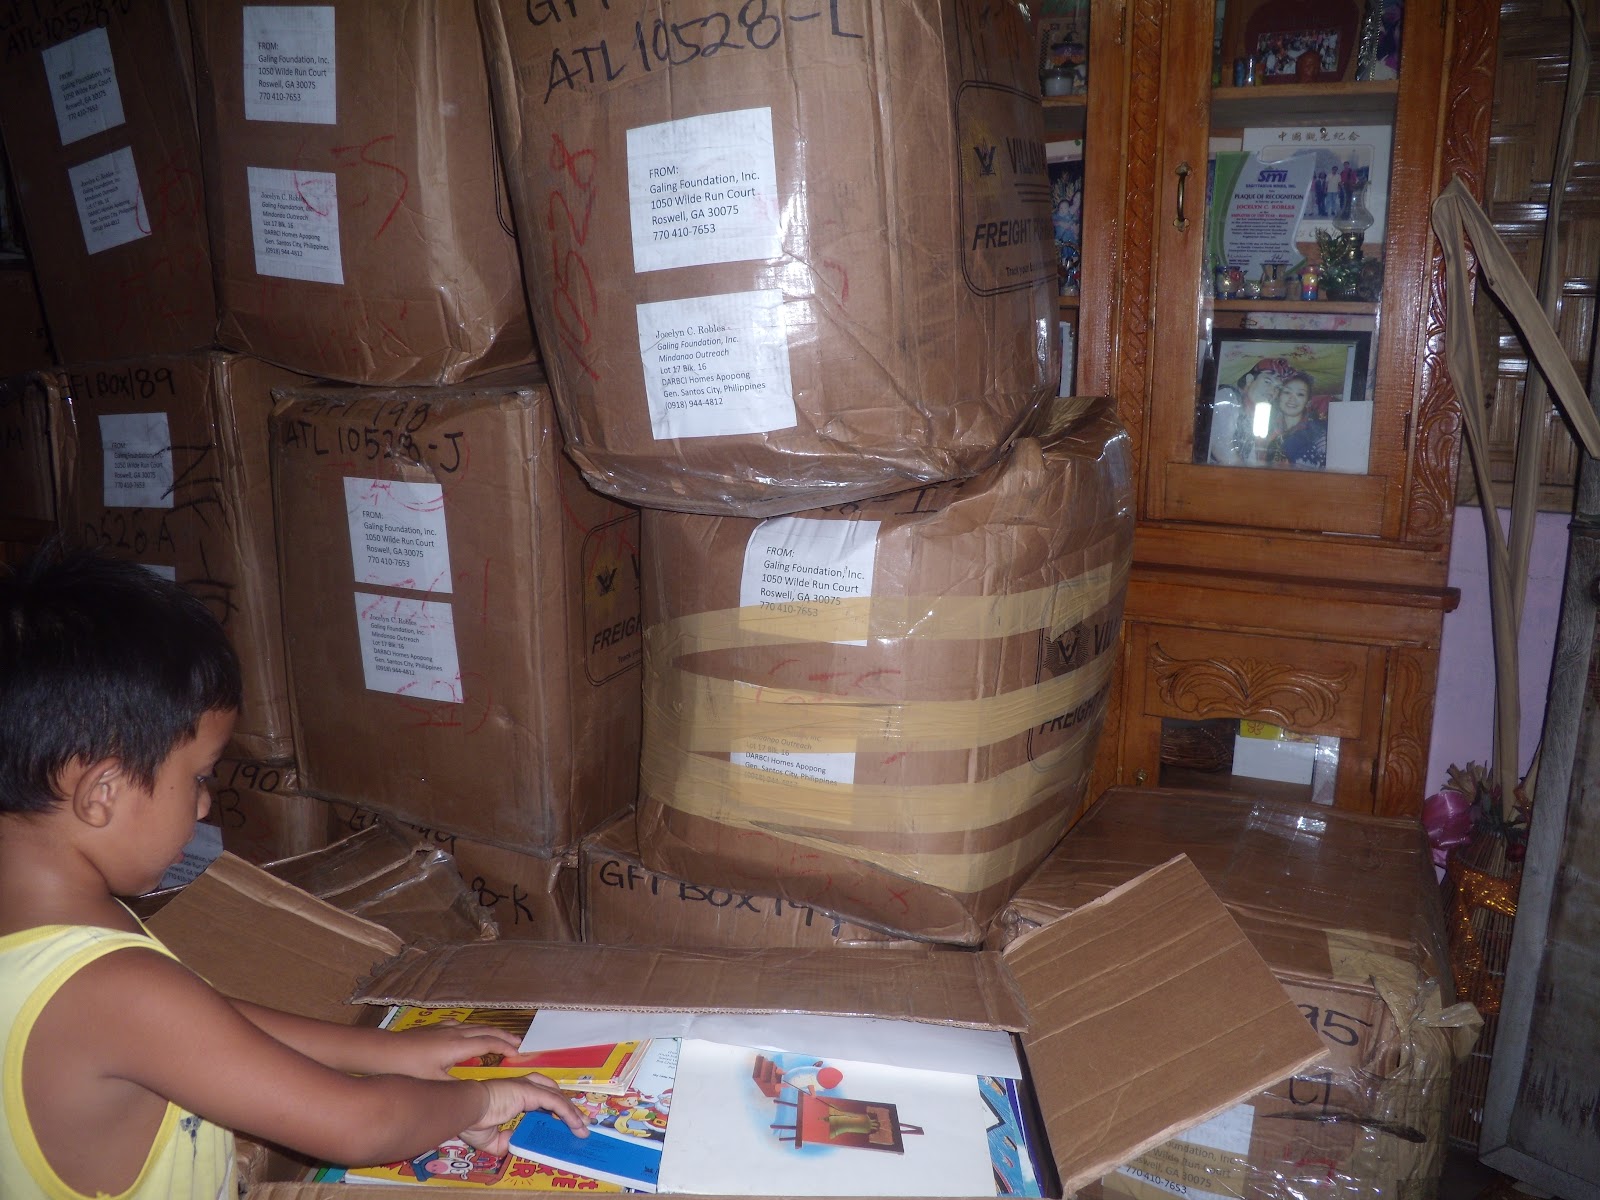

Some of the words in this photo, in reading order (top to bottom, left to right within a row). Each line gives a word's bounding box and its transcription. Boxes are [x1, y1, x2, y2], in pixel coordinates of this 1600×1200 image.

[258, 42, 278, 50] FROM:
[259, 55, 277, 64] Galing
[279, 55, 316, 64] Foundation,
[543, 39, 628, 104] ATL
[259, 80, 283, 89] Roswell,
[296, 81, 316, 89] 30075
[272, 93, 301, 101] 410-7653
[649, 166, 678, 178] FROM:
[650, 182, 678, 194] Galing
[680, 174, 738, 189] Foundation,
[742, 171, 760, 180] Inc.
[651, 198, 672, 210] 1050
[675, 194, 701, 205] Wilde
[705, 192, 723, 201] Run
[727, 188, 755, 198] Court
[652, 211, 688, 225] Roswell,
[691, 209, 705, 219] GA
[708, 205, 739, 217] 30075
[653, 230, 669, 240] 770
[672, 224, 716, 238] 410-7653
[656, 329, 684, 339] Jocelyn
[698, 324, 725, 334] Robles
[658, 342, 678, 350] Galing
[681, 338, 723, 349] Foundation,
[659, 353, 693, 362] Mindanao
[696, 349, 729, 358] Outreach
[662, 377, 687, 386] DARBCI
[690, 374, 714, 383] Homes
[716, 372, 750, 382] Apopong
[682, 388, 704, 396] Santos
[706, 386, 722, 395] City,
[724, 382, 765, 393] Philippines
[665, 400, 687, 410] (0918)
[689, 398, 723, 408] 944-4812
[285, 419, 330, 456] ATL
[362, 511, 383, 519] FROM:
[364, 522, 383, 532] Galing
[385, 524, 422, 535] Foundation,
[382, 535, 400, 543] Wilde
[416, 539, 434, 547] Court
[367, 545, 391, 555] Roswell,
[404, 549, 423, 557] 30075
[766, 546, 795, 558] FROM:
[381, 558, 409, 567] 410-7653
[764, 560, 790, 572] Galing
[792, 564, 845, 578] Foundation,
[848, 570, 864, 579] Inc.
[762, 574, 782, 584] 1050
[785, 576, 809, 587] Wilde
[812, 580, 830, 590] Run
[832, 583, 859, 593] Court
[760, 588, 795, 602] Roswell,
[797, 593, 810, 601] GA
[813, 595, 841, 605] 30075
[760, 601, 775, 611] 770
[778, 604, 818, 616] 410-7653
[746, 752, 769, 762] DARBCI
[771, 758, 794, 767] Homes
[796, 762, 826, 775] Apopong
[762, 766, 782, 776] Santos
[784, 769, 798, 779] City,
[800, 773, 838, 786] Philippines
[1152, 1149, 1179, 1163] Wilde
[1182, 1158, 1200, 1170] Run
[1144, 1171, 1187, 1194] 410-7653
[1166, 1168, 1179, 1178] GA
[1182, 1173, 1212, 1187] 30075
